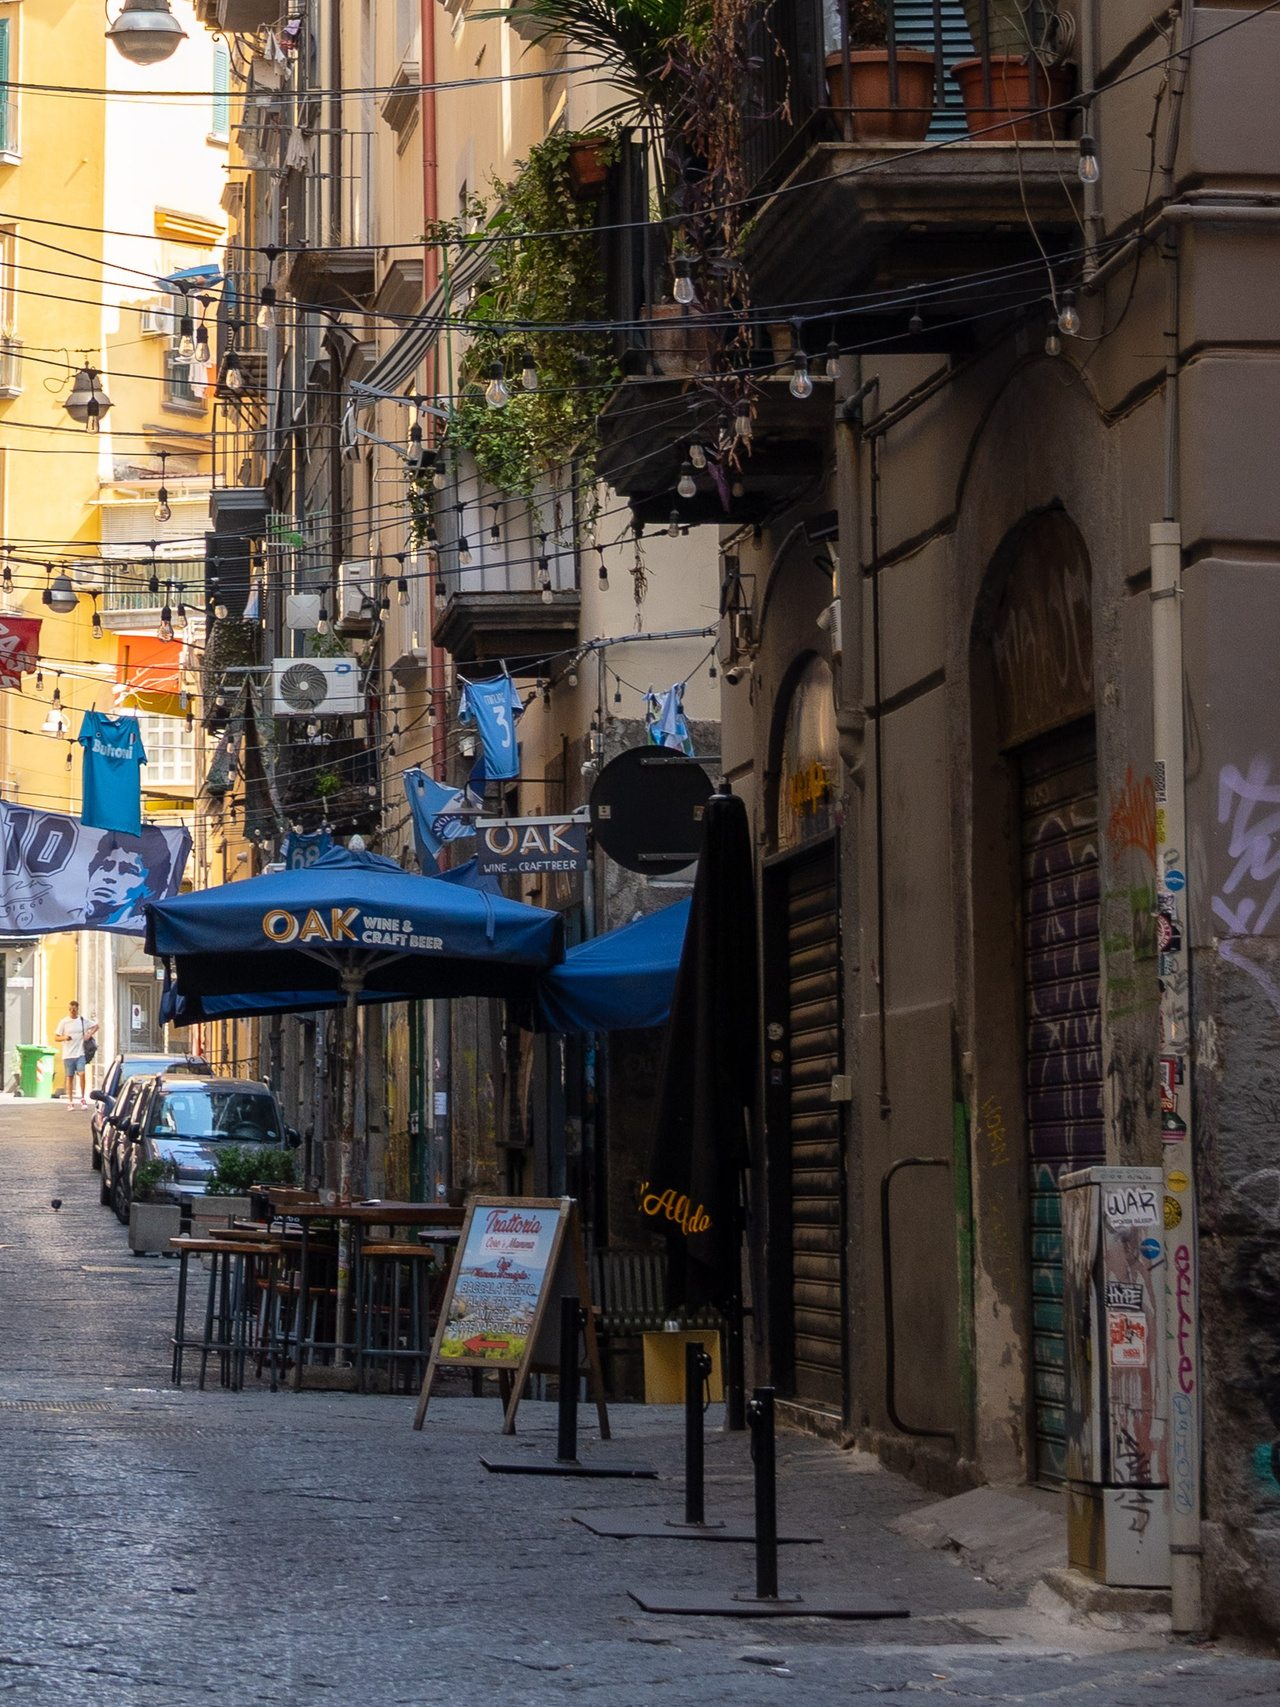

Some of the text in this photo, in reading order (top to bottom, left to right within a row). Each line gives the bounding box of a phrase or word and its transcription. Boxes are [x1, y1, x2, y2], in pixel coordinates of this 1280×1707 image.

[493, 705, 511, 748] 3
[3, 808, 80, 878] 10
[485, 823, 580, 856] OAK
[483, 863, 507, 873] WINE
[262, 907, 414, 944] OAK WINE &
[362, 930, 443, 950] CRAFT BEER
[485, 1209, 542, 1234] Trattoria
[475, 1321, 529, 1336] NAPOLETANE
